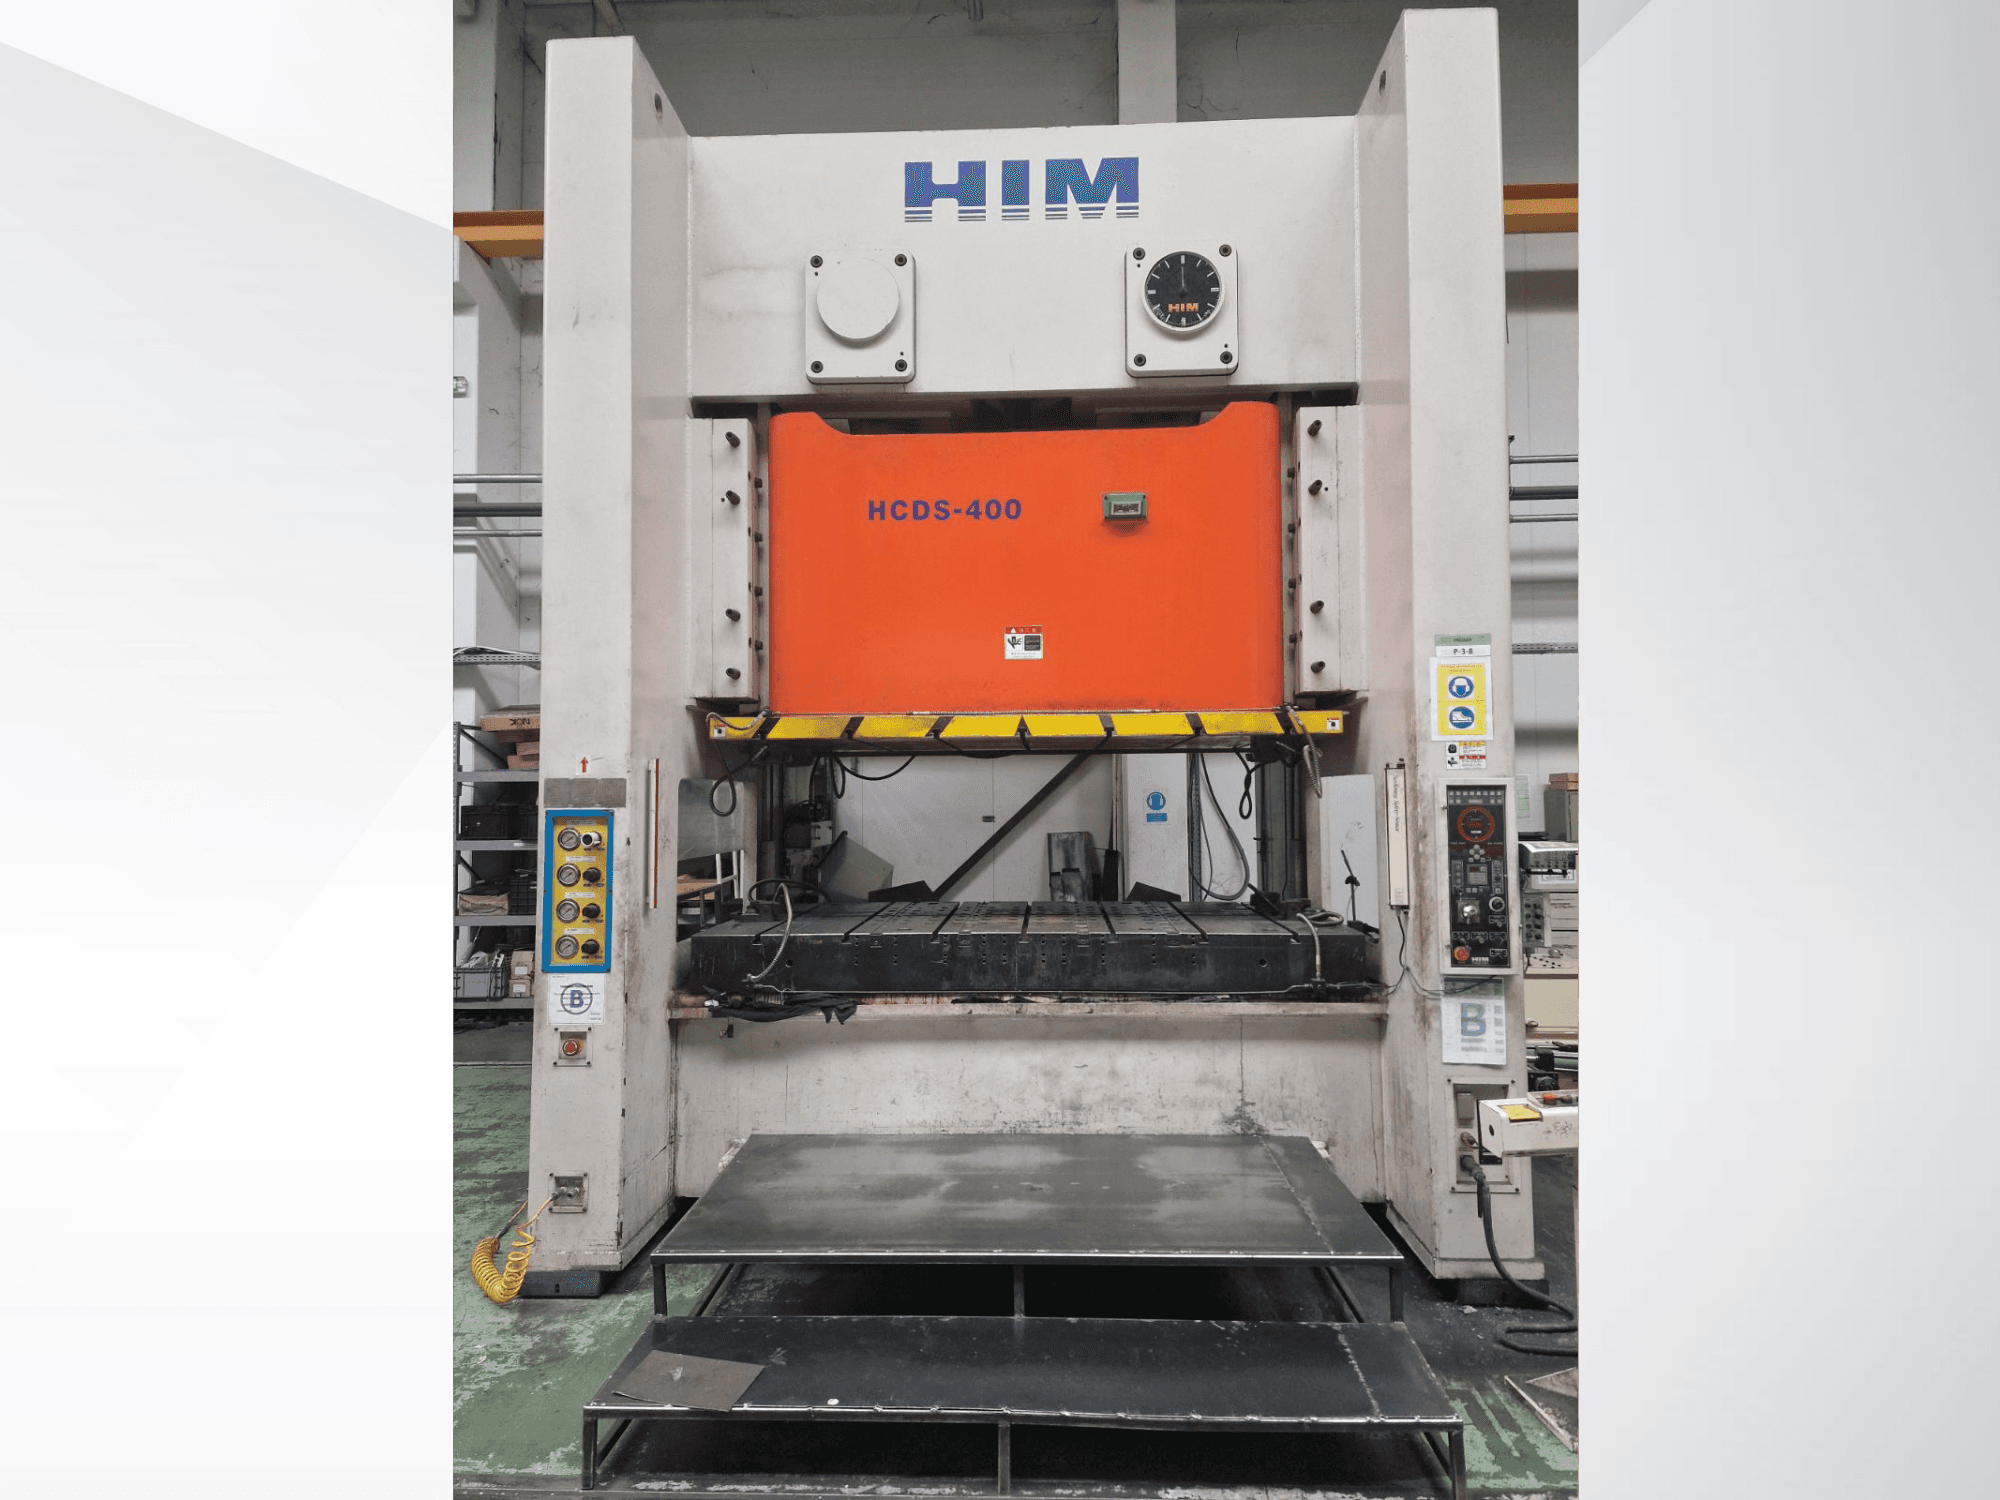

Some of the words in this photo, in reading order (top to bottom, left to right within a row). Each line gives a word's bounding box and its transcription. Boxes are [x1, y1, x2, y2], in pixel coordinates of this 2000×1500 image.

[904, 157, 1139, 222] HIM
[1168, 303, 1199, 313] HIM
[868, 499, 1022, 521] HCDS-400
[1453, 647, 1474, 655] P-3-8
[570, 989, 584, 1008] B
[1461, 1003, 1486, 1037] B
